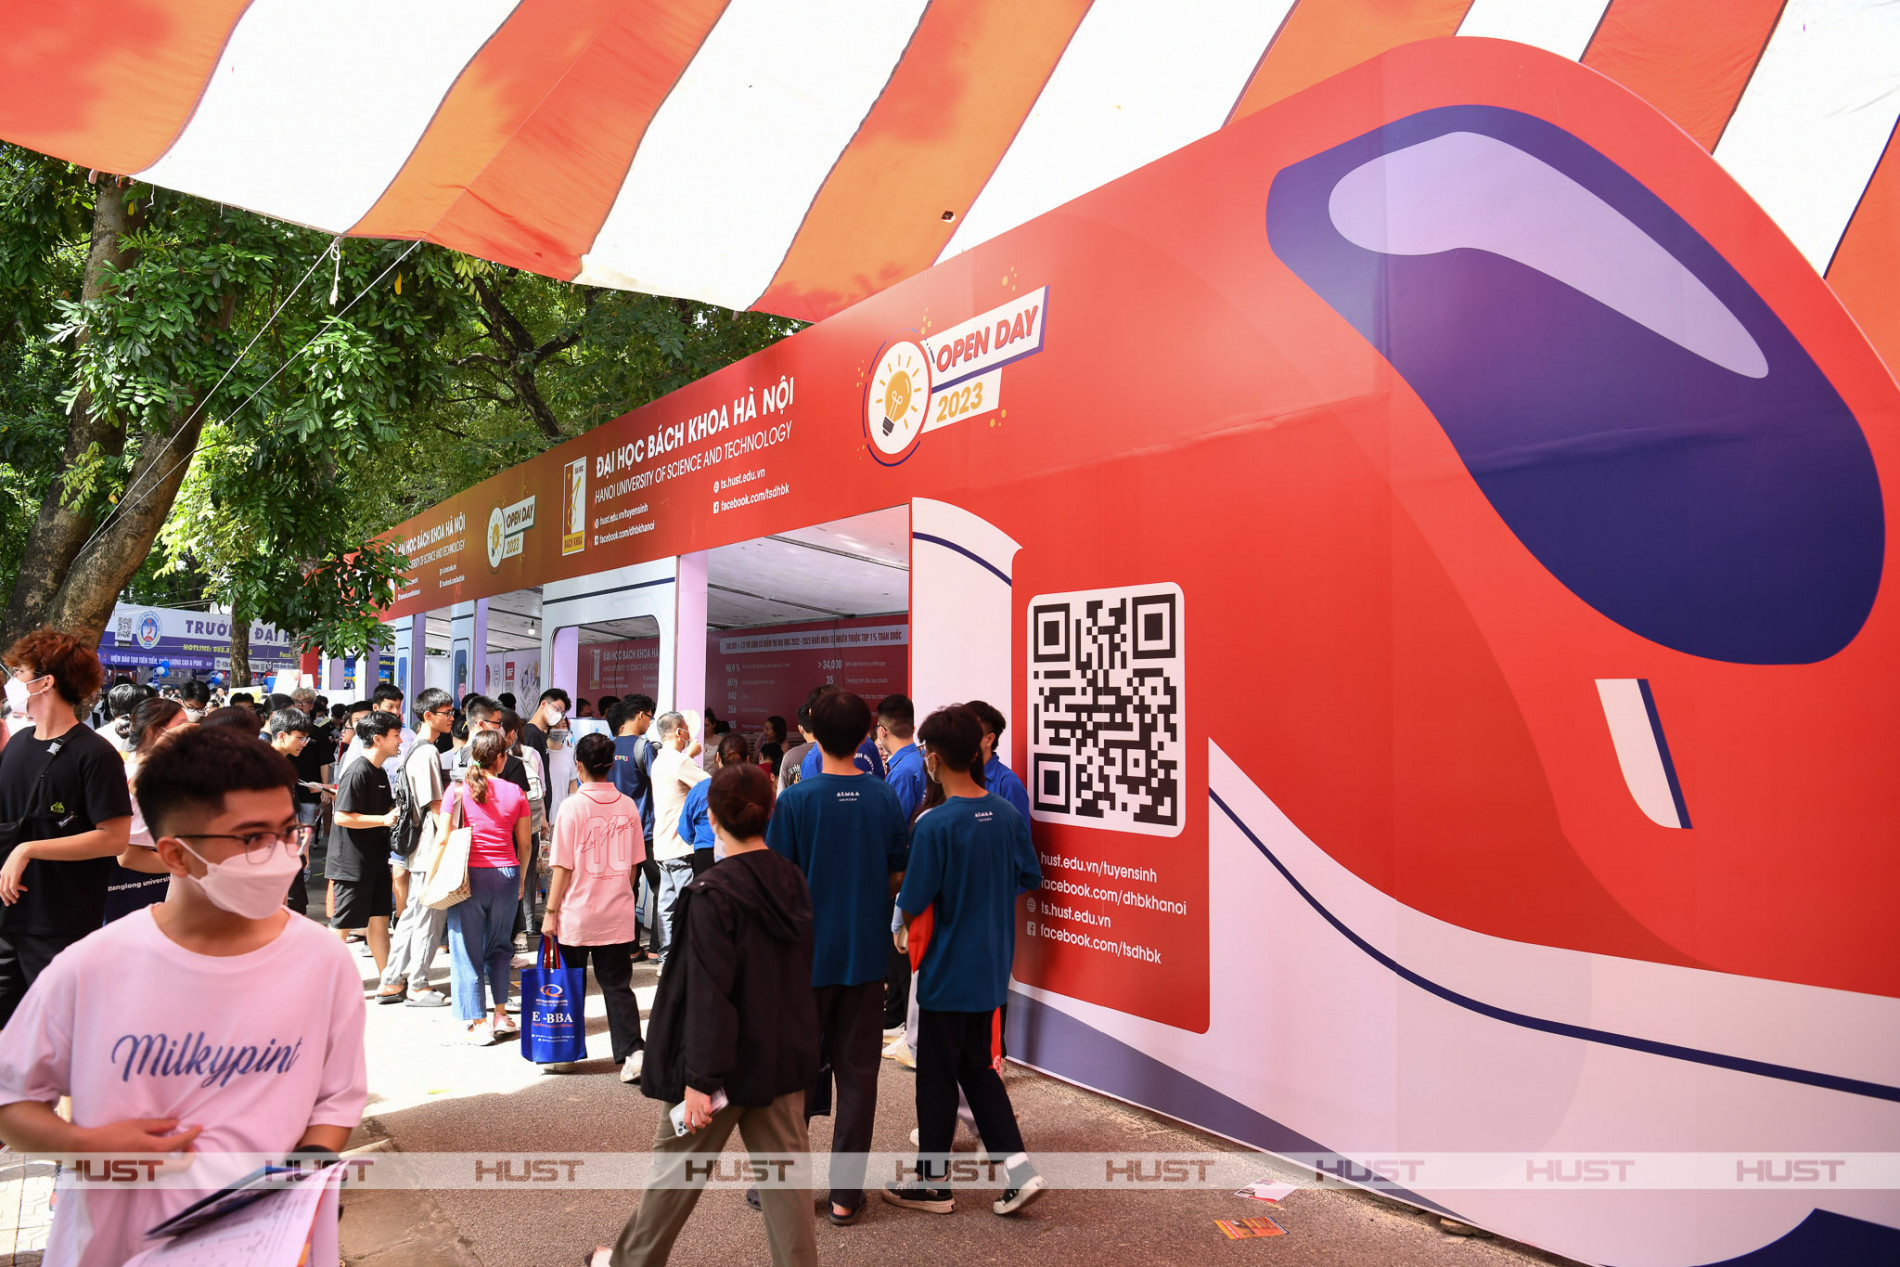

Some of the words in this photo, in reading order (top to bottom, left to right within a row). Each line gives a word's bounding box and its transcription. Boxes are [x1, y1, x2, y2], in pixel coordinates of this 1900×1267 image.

[936, 326, 990, 372] OPEN
[994, 305, 1038, 350] DAY
[936, 381, 983, 423] 2023
[596, 451, 614, 479] ĐẠI
[618, 438, 644, 471] HỌC
[648, 422, 684, 459] BÁCH
[688, 404, 729, 443] KHOA
[734, 386, 757, 426] HÀ
[762, 375, 794, 415] NỘI
[595, 484, 615, 504] HANOI
[617, 470, 654, 496] UNIVERSITY
[655, 466, 666, 483] OF
[668, 454, 701, 479] SCIENCE
[703, 446, 722, 467] AND
[725, 420, 792, 460] TECHNOLOGY
[721, 468, 765, 489] ts.hust.edu.vn
[721, 483, 789, 511] facebook.com/tsdhbk
[506, 512, 521, 529] OPEN
[522, 504, 533, 522] DAY
[186, 620, 232, 636] TRƯỜ
[1041, 852, 1157, 883] hust.edu.vn/tuyensinh
[1041, 877, 1187, 915] facebook.com/dhbkhanoi
[1041, 902, 1111, 928] ts.hust.edu.vn
[1041, 925, 1161, 964] facebook.com/tsdhbk
[112, 1031, 302, 1088] Milkypint
